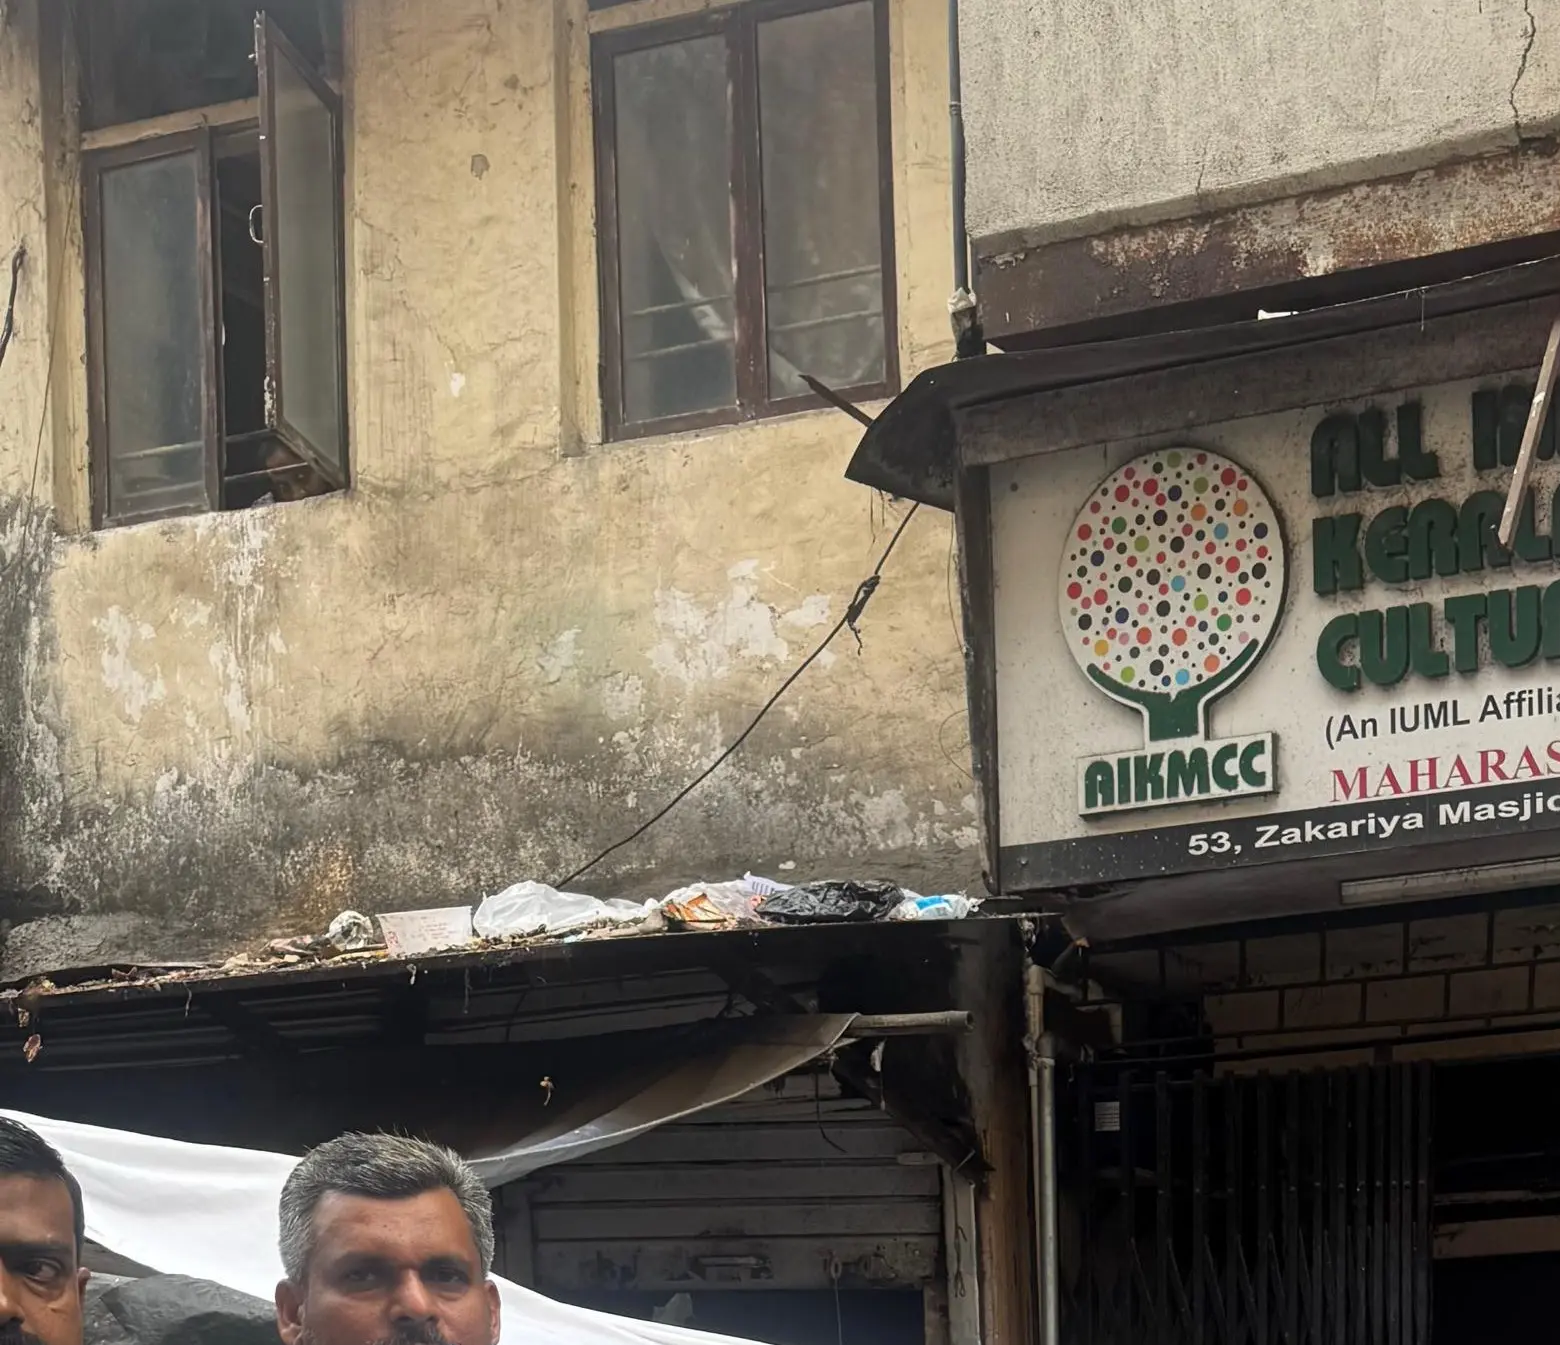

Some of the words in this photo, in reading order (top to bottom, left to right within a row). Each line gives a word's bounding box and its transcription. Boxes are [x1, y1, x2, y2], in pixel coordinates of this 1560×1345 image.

[1311, 400, 1440, 498] ALL
[1325, 714, 1378, 750] (An
[1390, 700, 1470, 736] IUML
[1084, 740, 1267, 810] AIKMCC
[1188, 832, 1242, 856] 53,
[1255, 813, 1424, 849] Zakariya
